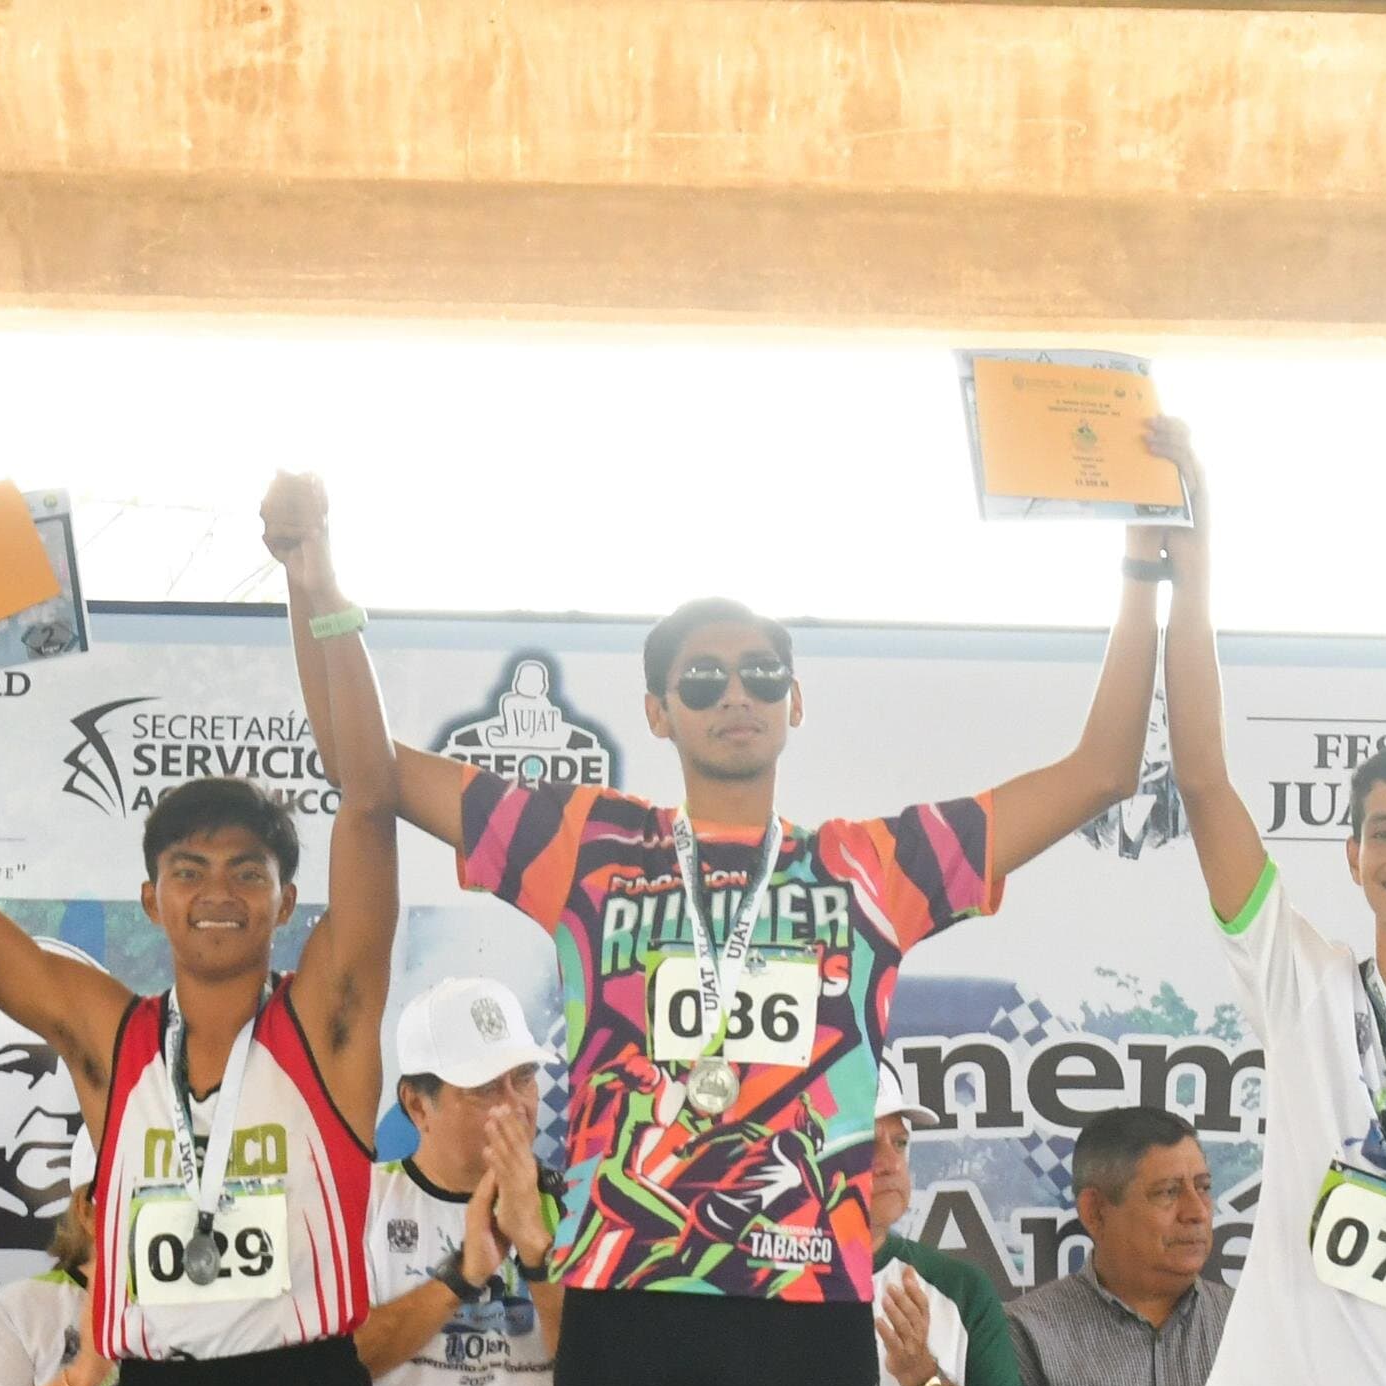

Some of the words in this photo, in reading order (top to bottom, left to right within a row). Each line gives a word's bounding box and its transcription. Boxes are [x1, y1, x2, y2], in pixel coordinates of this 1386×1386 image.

[132, 709, 312, 742] SECRETARÍA
[132, 743, 327, 780] SERVICIO
[600, 882, 850, 977] RUER
[726, 919, 752, 961] UJAT
[699, 966, 720, 1012] UJAT
[667, 987, 800, 1044] 086
[749, 1231, 833, 1264] TABASCO
